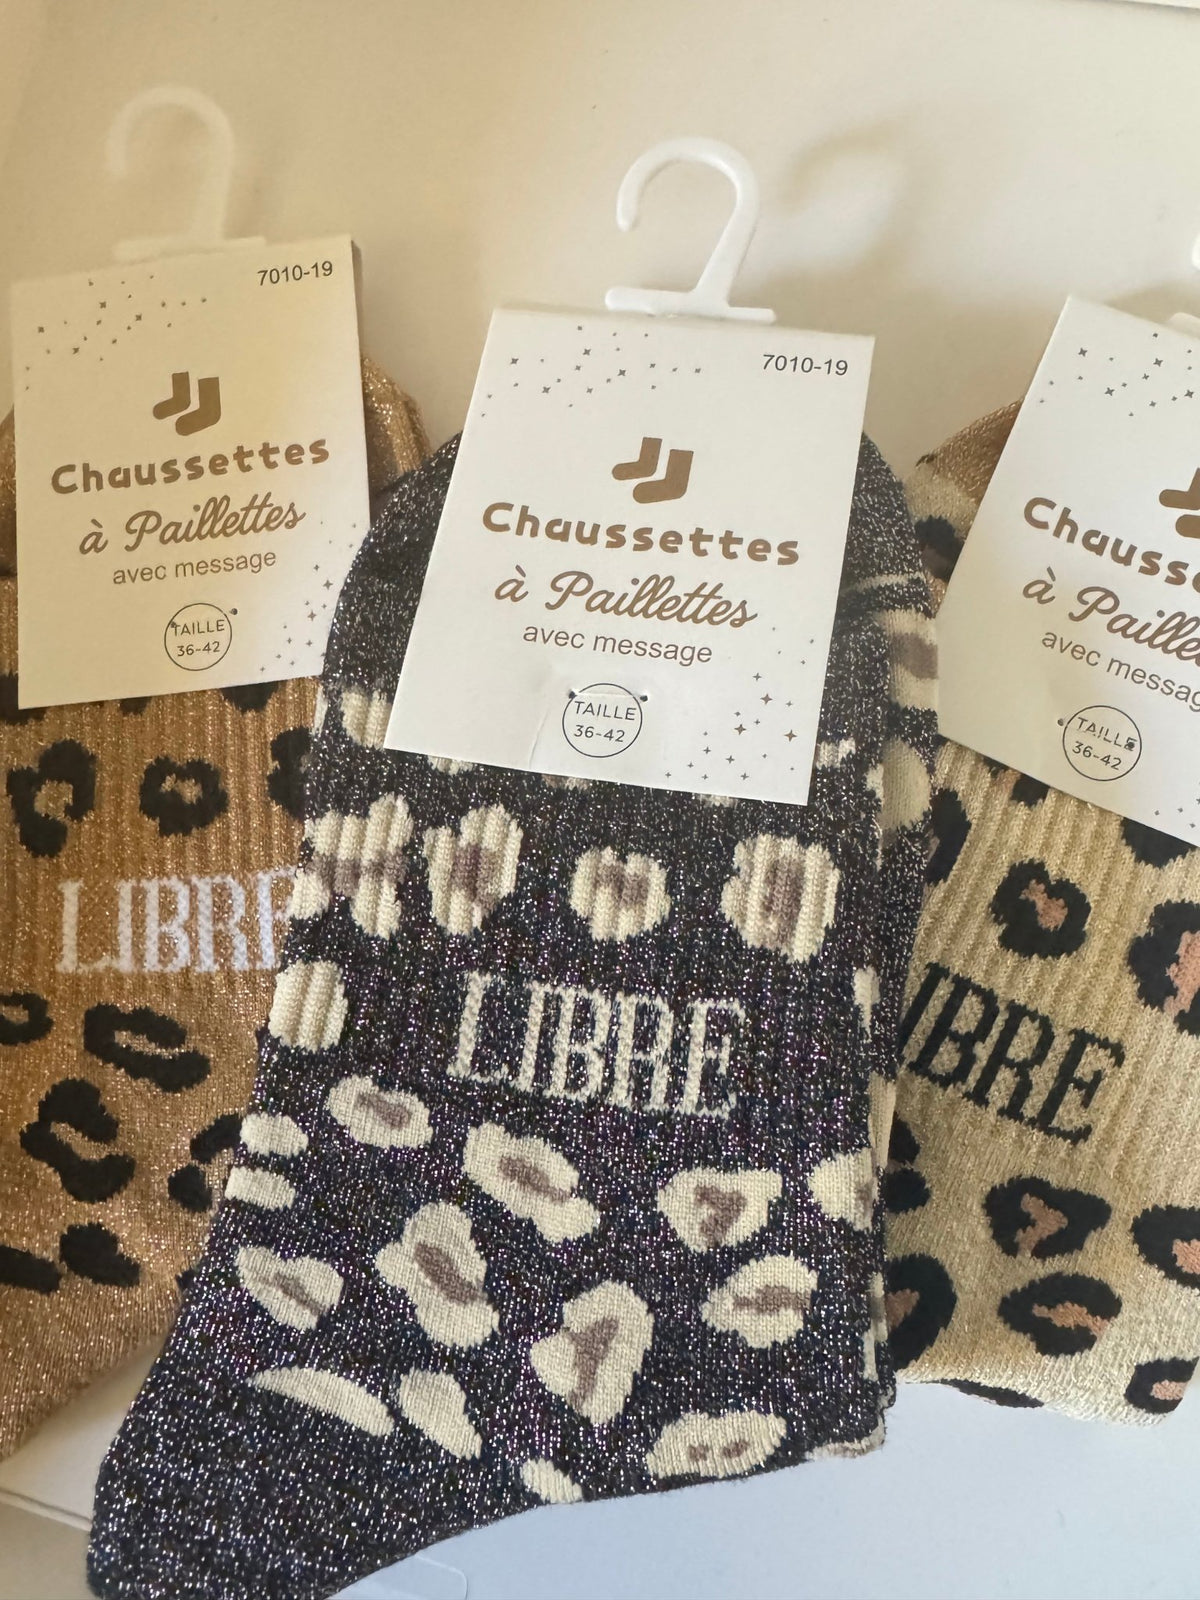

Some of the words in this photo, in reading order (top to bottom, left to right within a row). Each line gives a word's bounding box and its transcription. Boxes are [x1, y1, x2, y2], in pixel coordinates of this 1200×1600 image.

[257, 260, 334, 287] 7010-19
[762, 353, 849, 376] 7010-19
[51, 438, 330, 495] Chaussettes
[79, 519, 108, 555] à
[125, 491, 306, 552] Paillettes
[482, 502, 800, 566] Chaussettes
[112, 567, 167, 585] avec
[174, 550, 277, 579] message
[494, 564, 529, 603] à
[544, 570, 758, 629] Paillettes
[171, 618, 226, 636] TAILLE
[1022, 566, 1056, 605] à
[1068, 586, 1200, 667] Paille
[176, 640, 221, 657] 36-42
[522, 624, 585, 649] avec
[593, 635, 713, 667] message
[1041, 629, 1100, 668] avec
[573, 700, 636, 722] TAILLE
[573, 724, 626, 744] 36-42
[1076, 717, 1137, 752] TAILLE
[1071, 740, 1122, 772] 36-42
[446, 968, 746, 1120] LIBRE
[901, 962, 1125, 1144] IBRE
